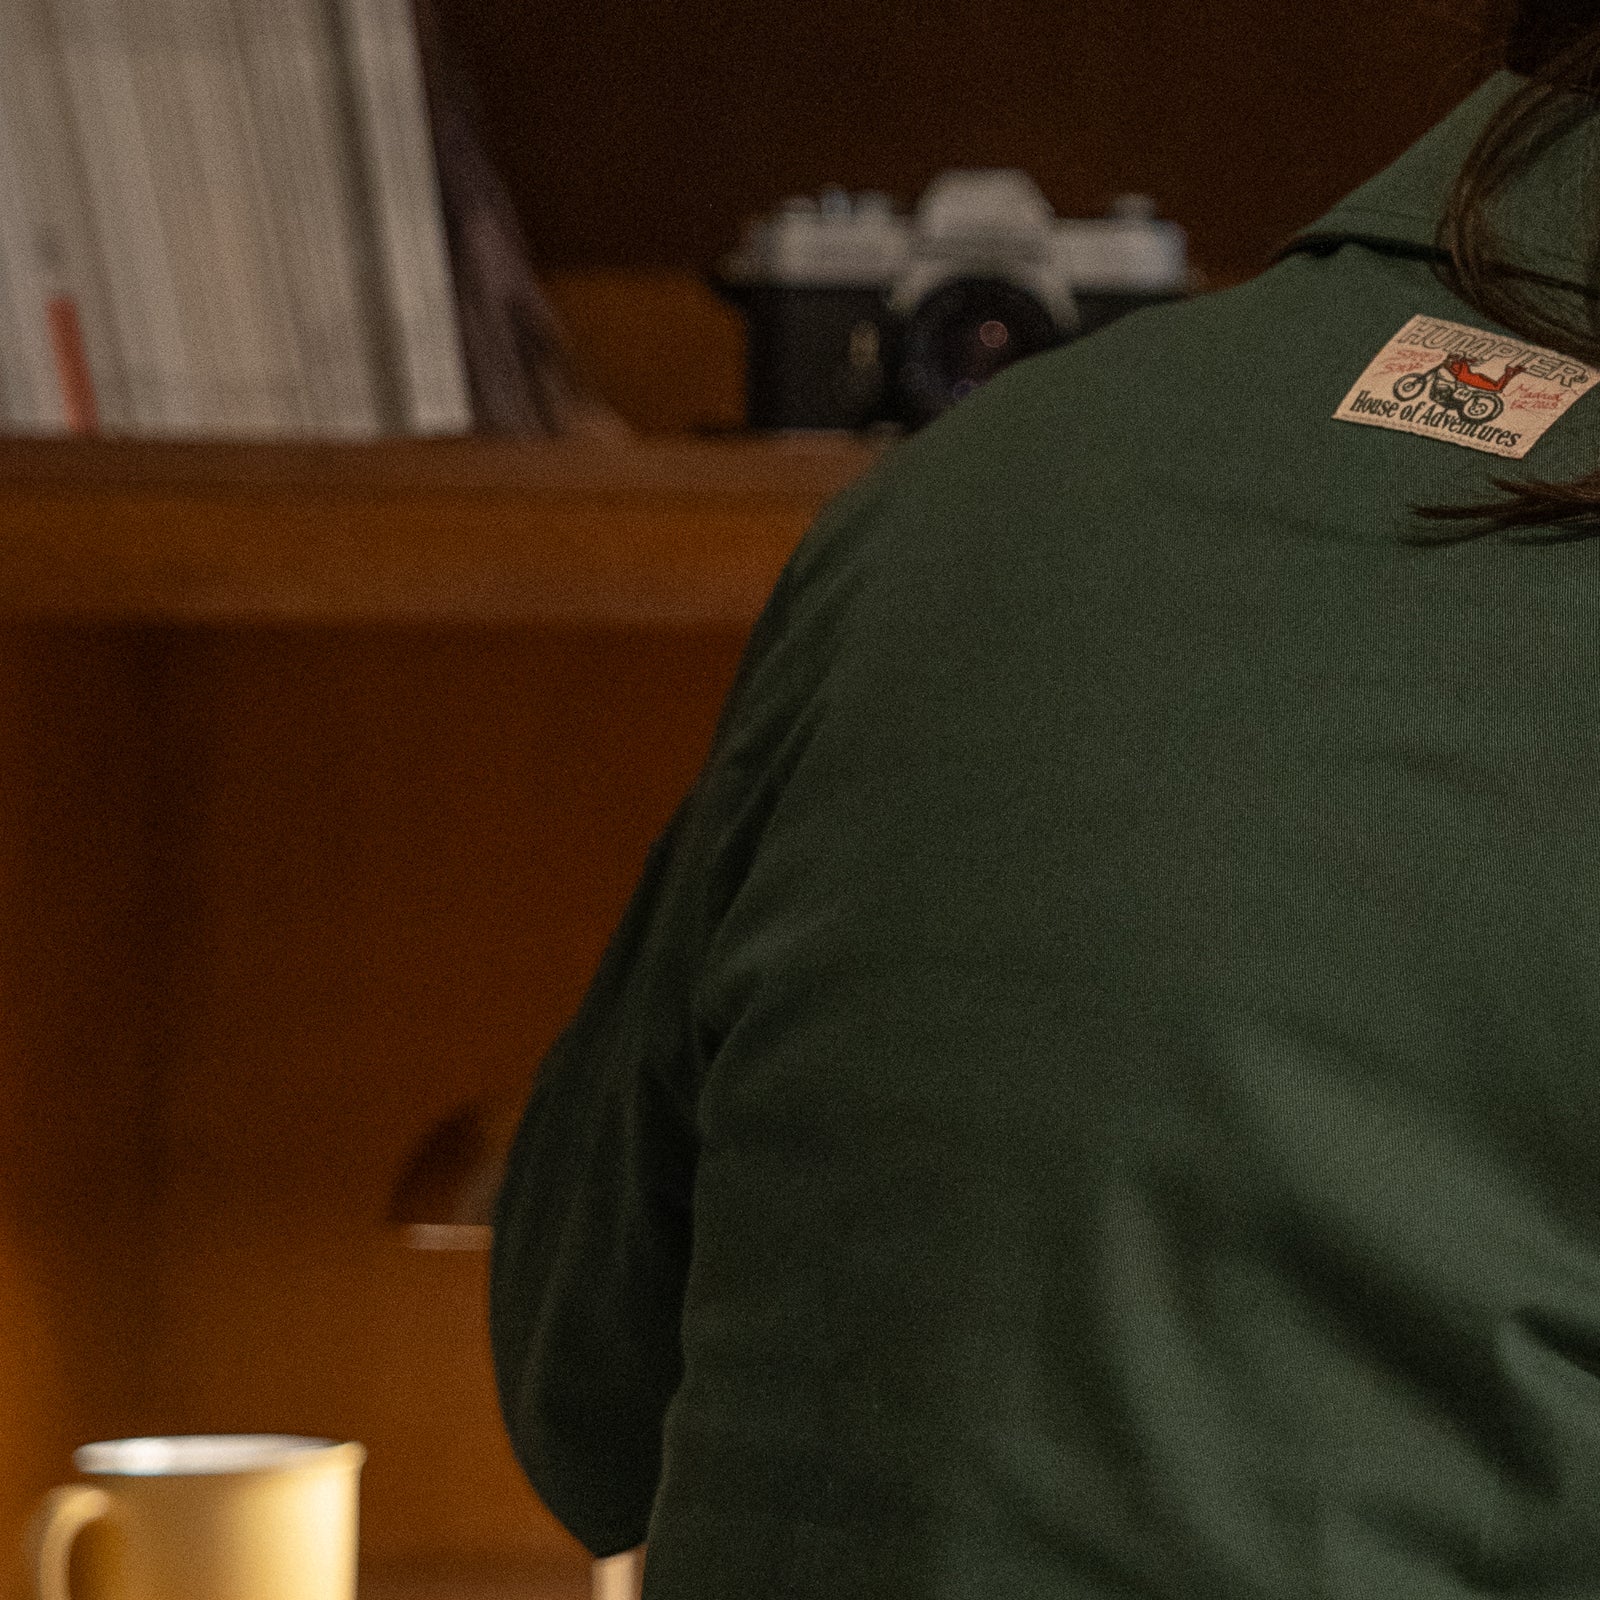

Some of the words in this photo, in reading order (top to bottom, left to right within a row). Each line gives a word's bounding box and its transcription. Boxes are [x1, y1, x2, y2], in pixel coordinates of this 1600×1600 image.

[1350, 390, 1399, 418] House
[1400, 402, 1426, 422] of
[1416, 404, 1521, 447] Adventures
